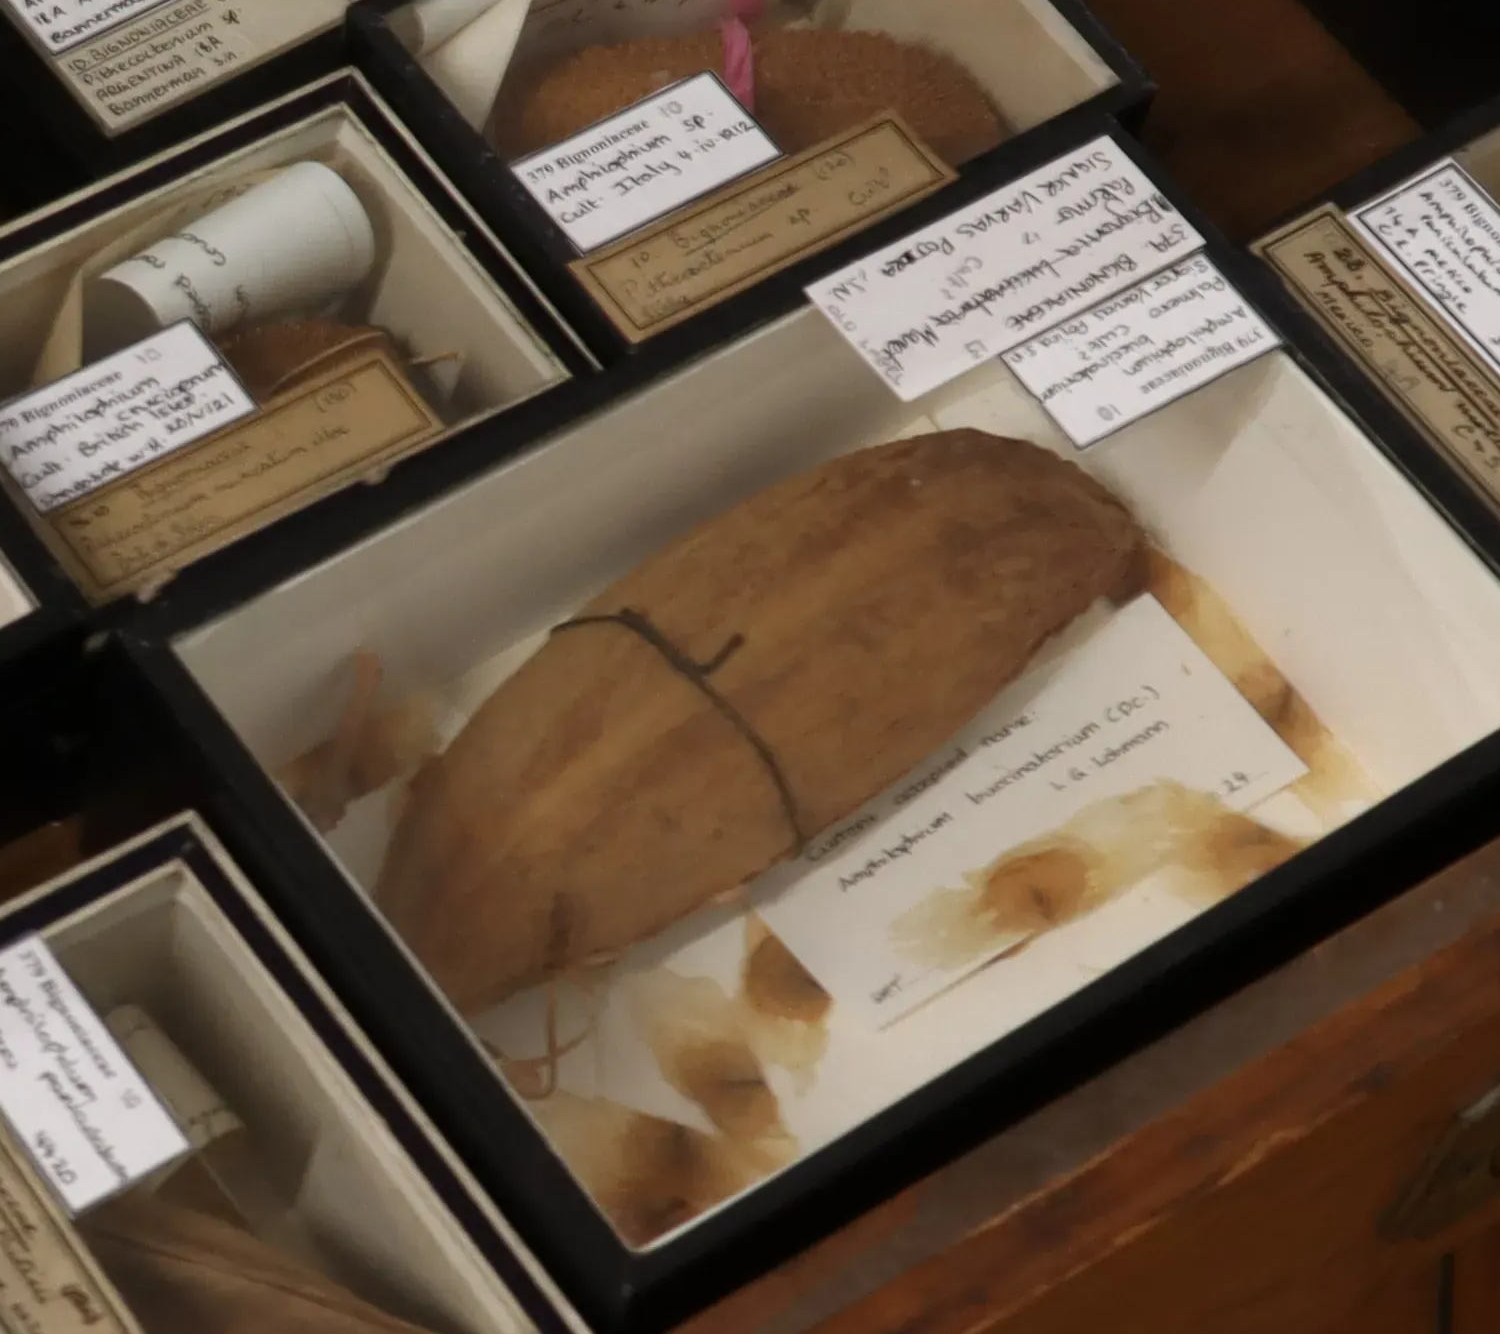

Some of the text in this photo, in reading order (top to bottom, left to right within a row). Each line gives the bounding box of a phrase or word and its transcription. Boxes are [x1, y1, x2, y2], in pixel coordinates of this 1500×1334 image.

[107, 67, 206, 117] Bannerman
[527, 164, 554, 180] 379
[554, 120, 649, 170] Bignoniaceae
[1440, 179, 1467, 202] 379
[1140, 341, 1237, 394] Bignoniaceae
[20, 372, 121, 424] Bignoniaceae
